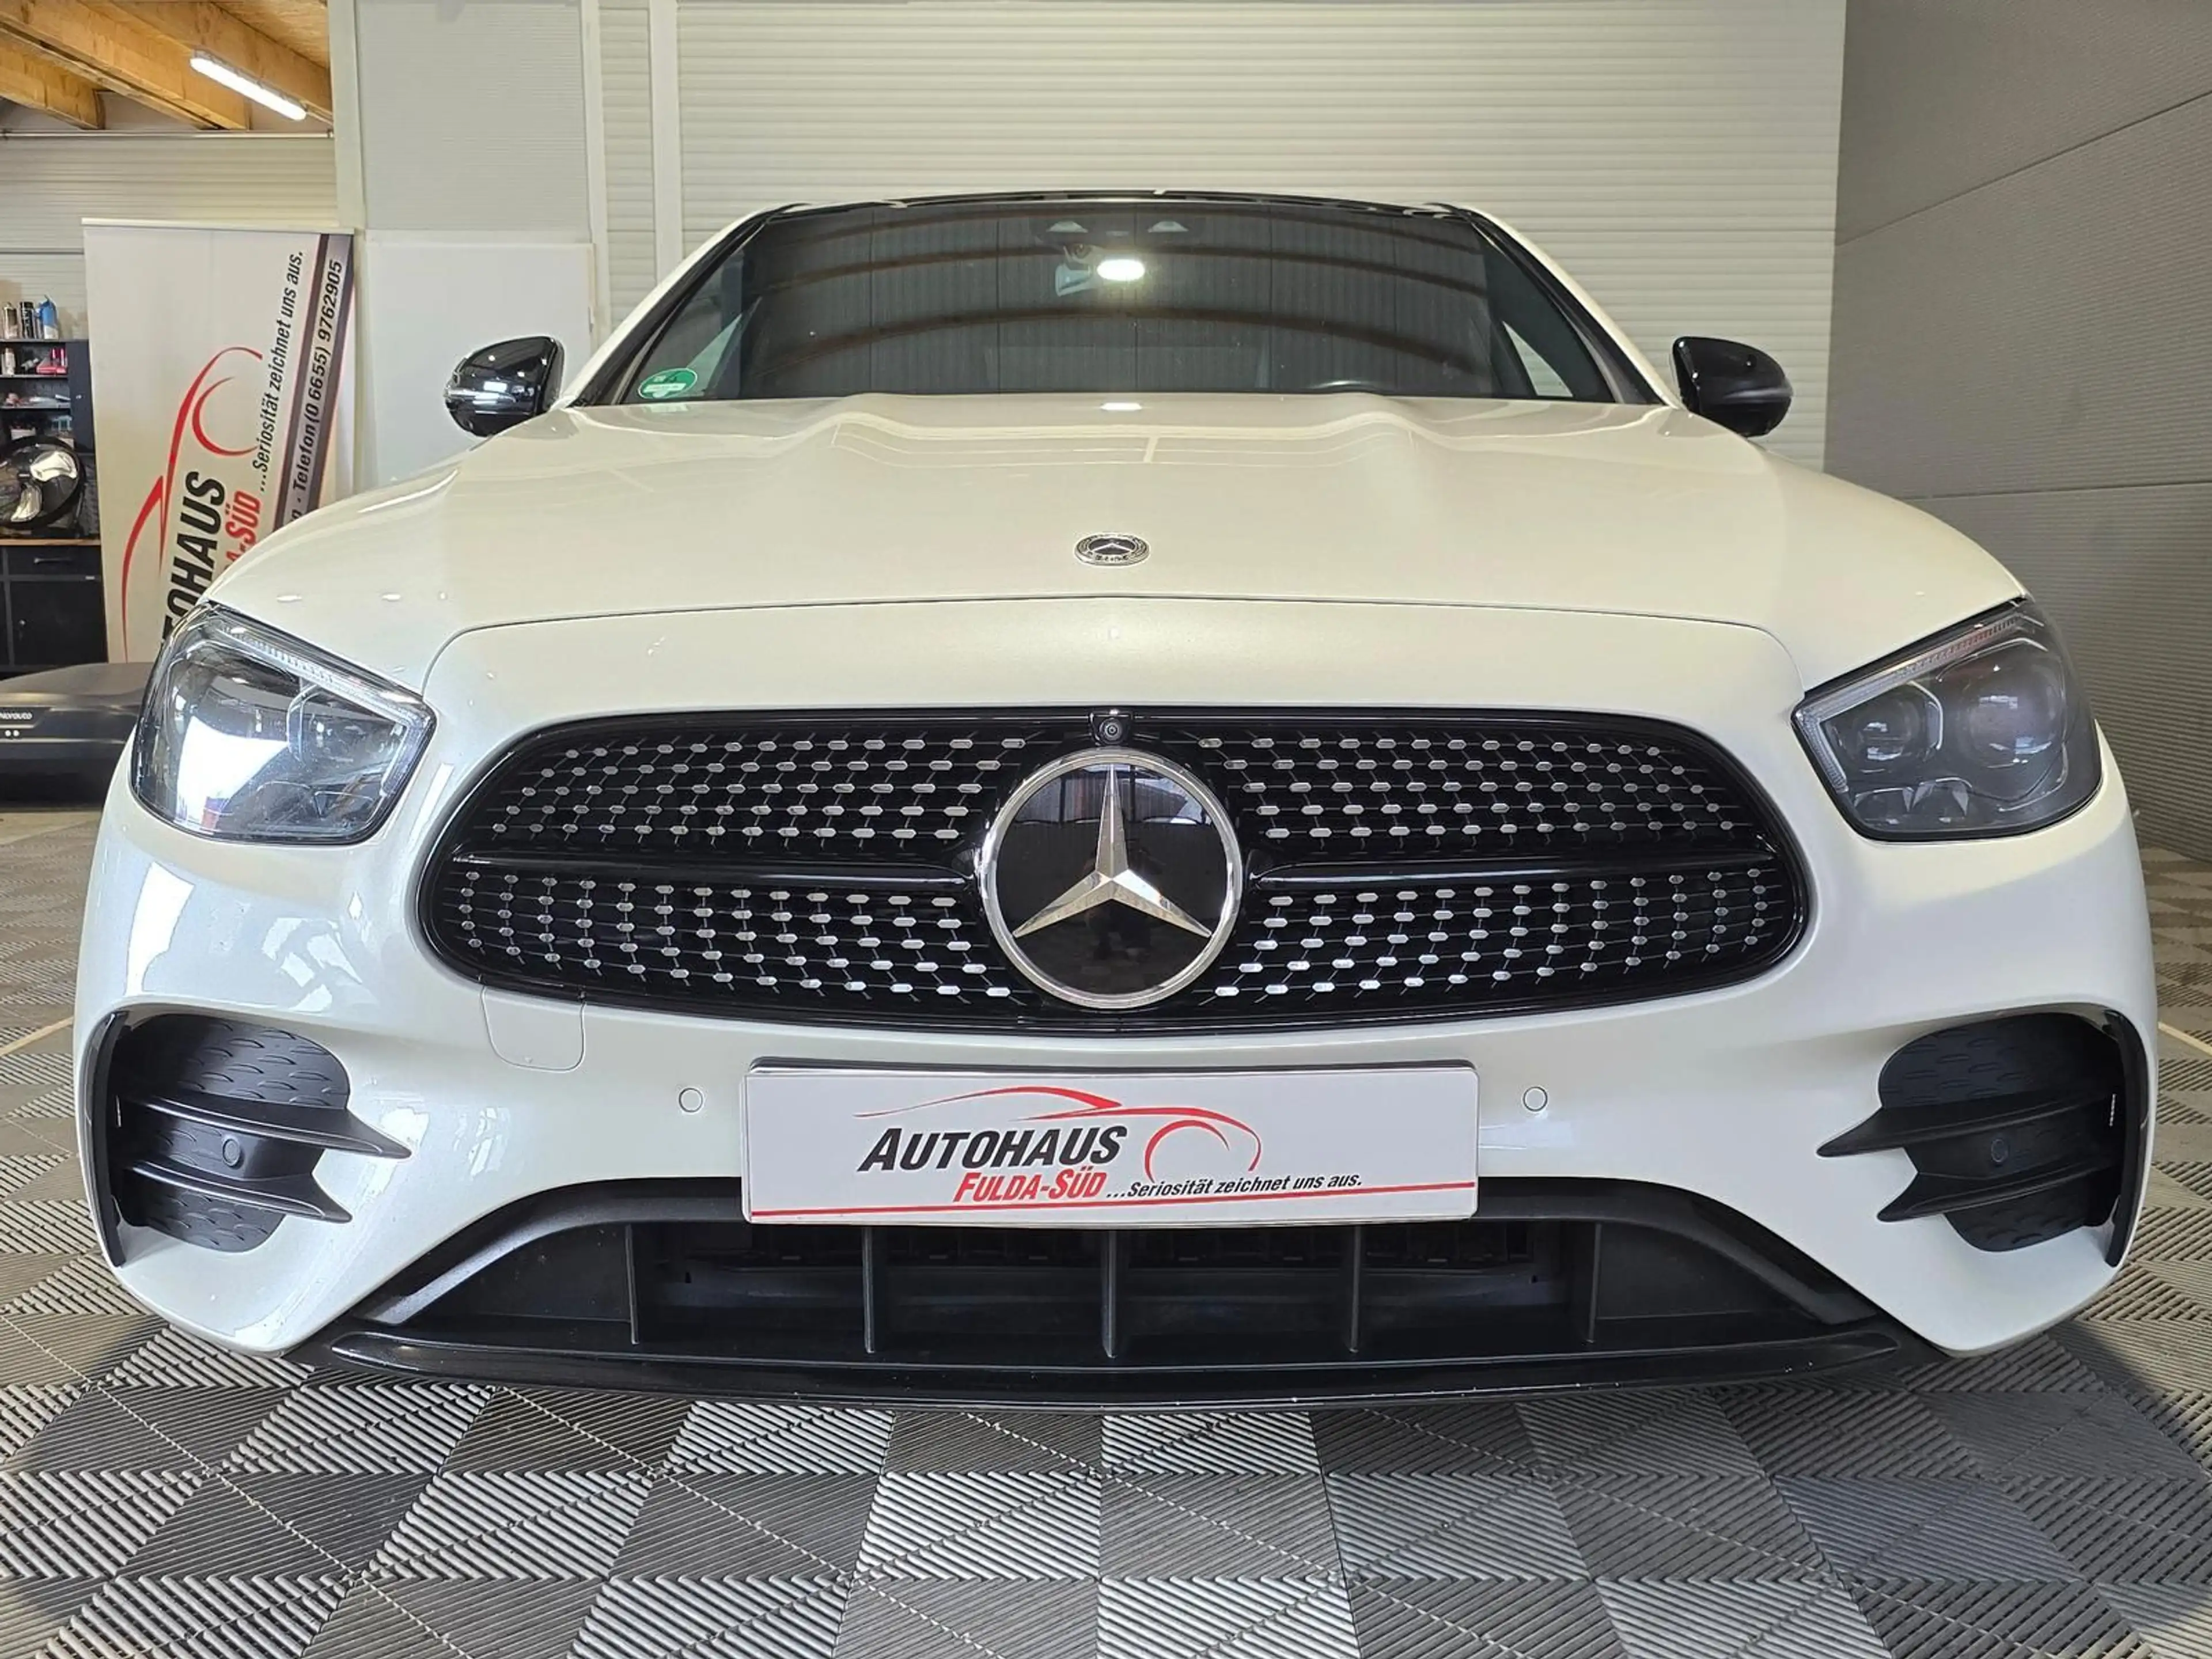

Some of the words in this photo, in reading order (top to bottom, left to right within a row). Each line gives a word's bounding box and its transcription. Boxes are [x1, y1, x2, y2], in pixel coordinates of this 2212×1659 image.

[286, 251, 303, 285] aus.
[281, 287, 297, 319] uns
[317, 260, 342, 342] 9762905
[268, 320, 291, 392] zeichnet
[252, 392, 279, 492] ...Seriosität
[857, 1126, 1127, 1172] AUTOHAUS
[953, 1166, 1107, 1203] FULDA-SÜD
[1106, 1179, 1213, 1198] ...Seriosität
[1214, 1175, 1291, 1194] zeichnet
[1293, 1177, 1325, 1190] uns
[1327, 1173, 1362, 1188] aus.
